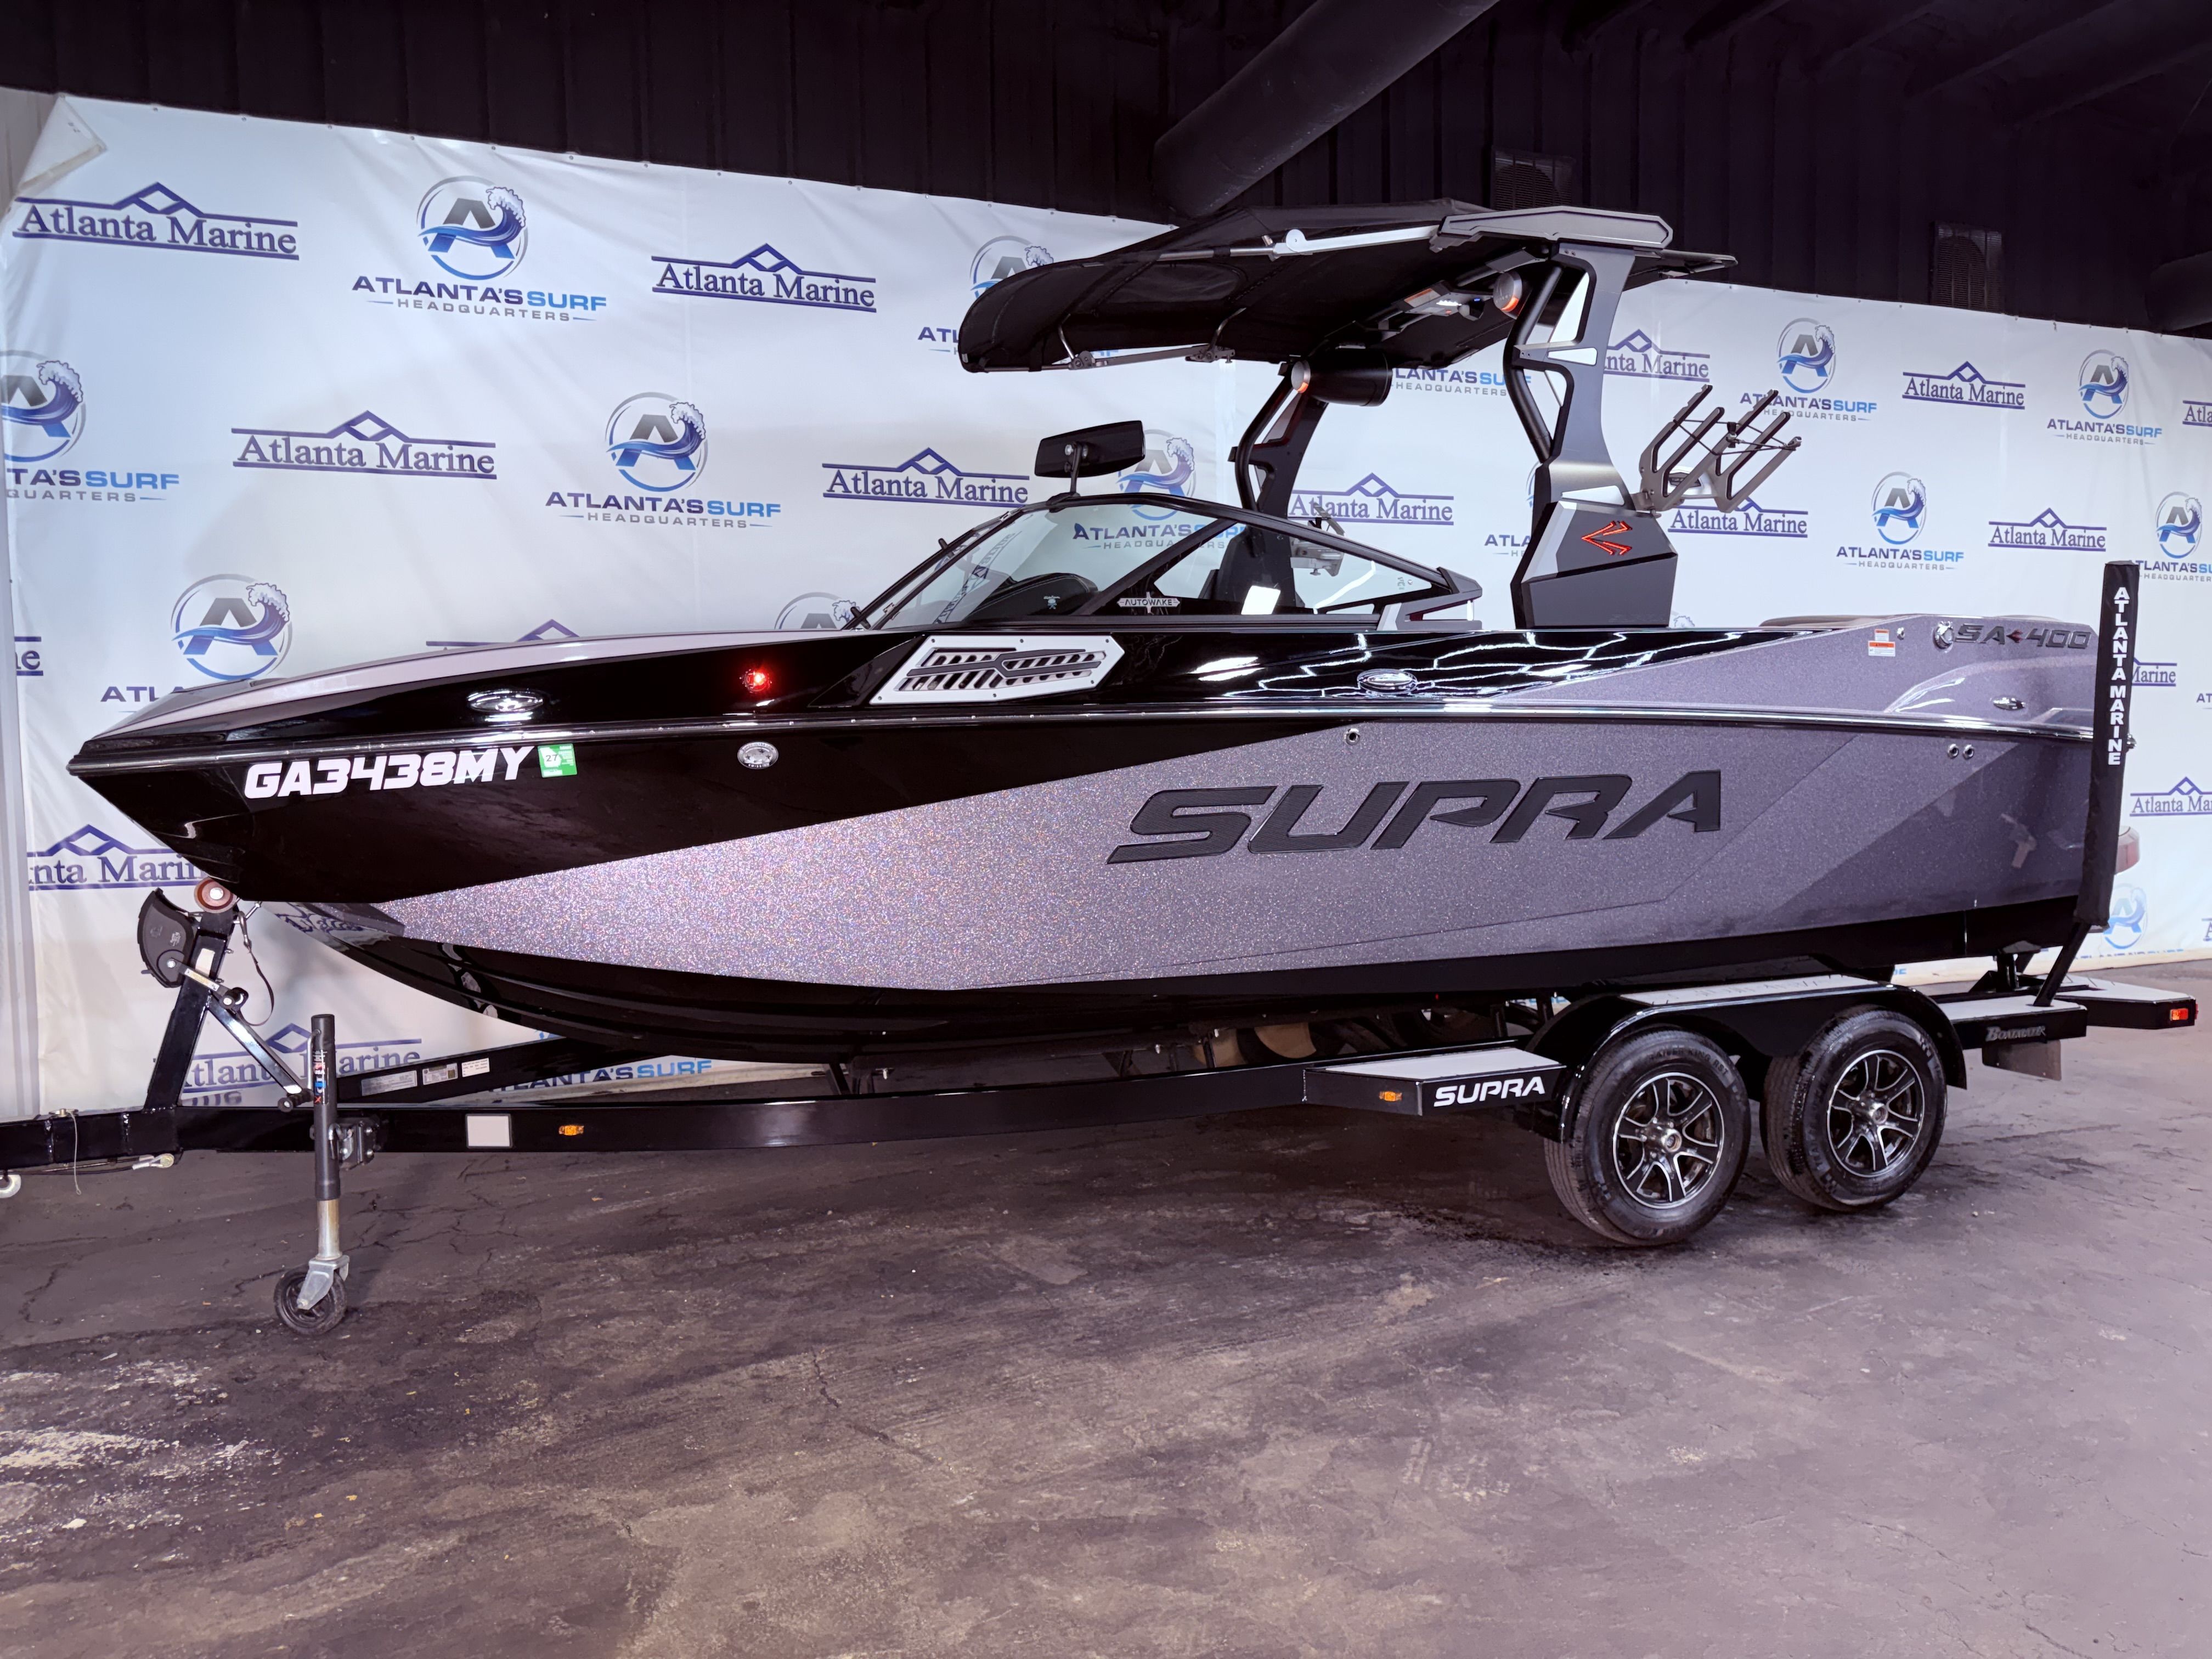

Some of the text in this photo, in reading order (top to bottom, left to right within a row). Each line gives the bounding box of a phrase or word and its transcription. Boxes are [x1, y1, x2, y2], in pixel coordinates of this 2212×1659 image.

[17, 205, 297, 254] Atlanta Marine
[656, 263, 875, 307] Atlanta Marine
[397, 298, 570, 322] HEADQUARTERS
[527, 291, 607, 312] SURF
[1395, 368, 1477, 383] LANTA'S
[1641, 353, 1709, 378] Marine
[1396, 382, 1507, 396] HEADQUARTERS
[1904, 377, 2024, 407] Atlanta Marine
[2066, 433, 2145, 445] HEADQUARTERS
[236, 435, 495, 475] Atlanta Marine
[85, 471, 179, 490] SURF
[826, 469, 1029, 504] Atlanta Marine
[7, 489, 136, 502] QUARTERS
[707, 500, 782, 518] SURF
[1376, 498, 1453, 521] Marine
[588, 512, 747, 529] HEADQUARTERS
[1671, 510, 1808, 534] Atlanta Marine
[1990, 526, 2106, 548] Atlanta Marine
[1859, 560, 1944, 571] HEADQUARTERS
[2144, 573, 2212, 582] HEADQUARTER
[2107, 586, 2130, 765] ATLANTA MARINE
[2131, 795, 2183, 813] Atlanta
[1105, 770, 1722, 865] SUPRA
[1434, 1076, 1545, 1107] SUPRA
